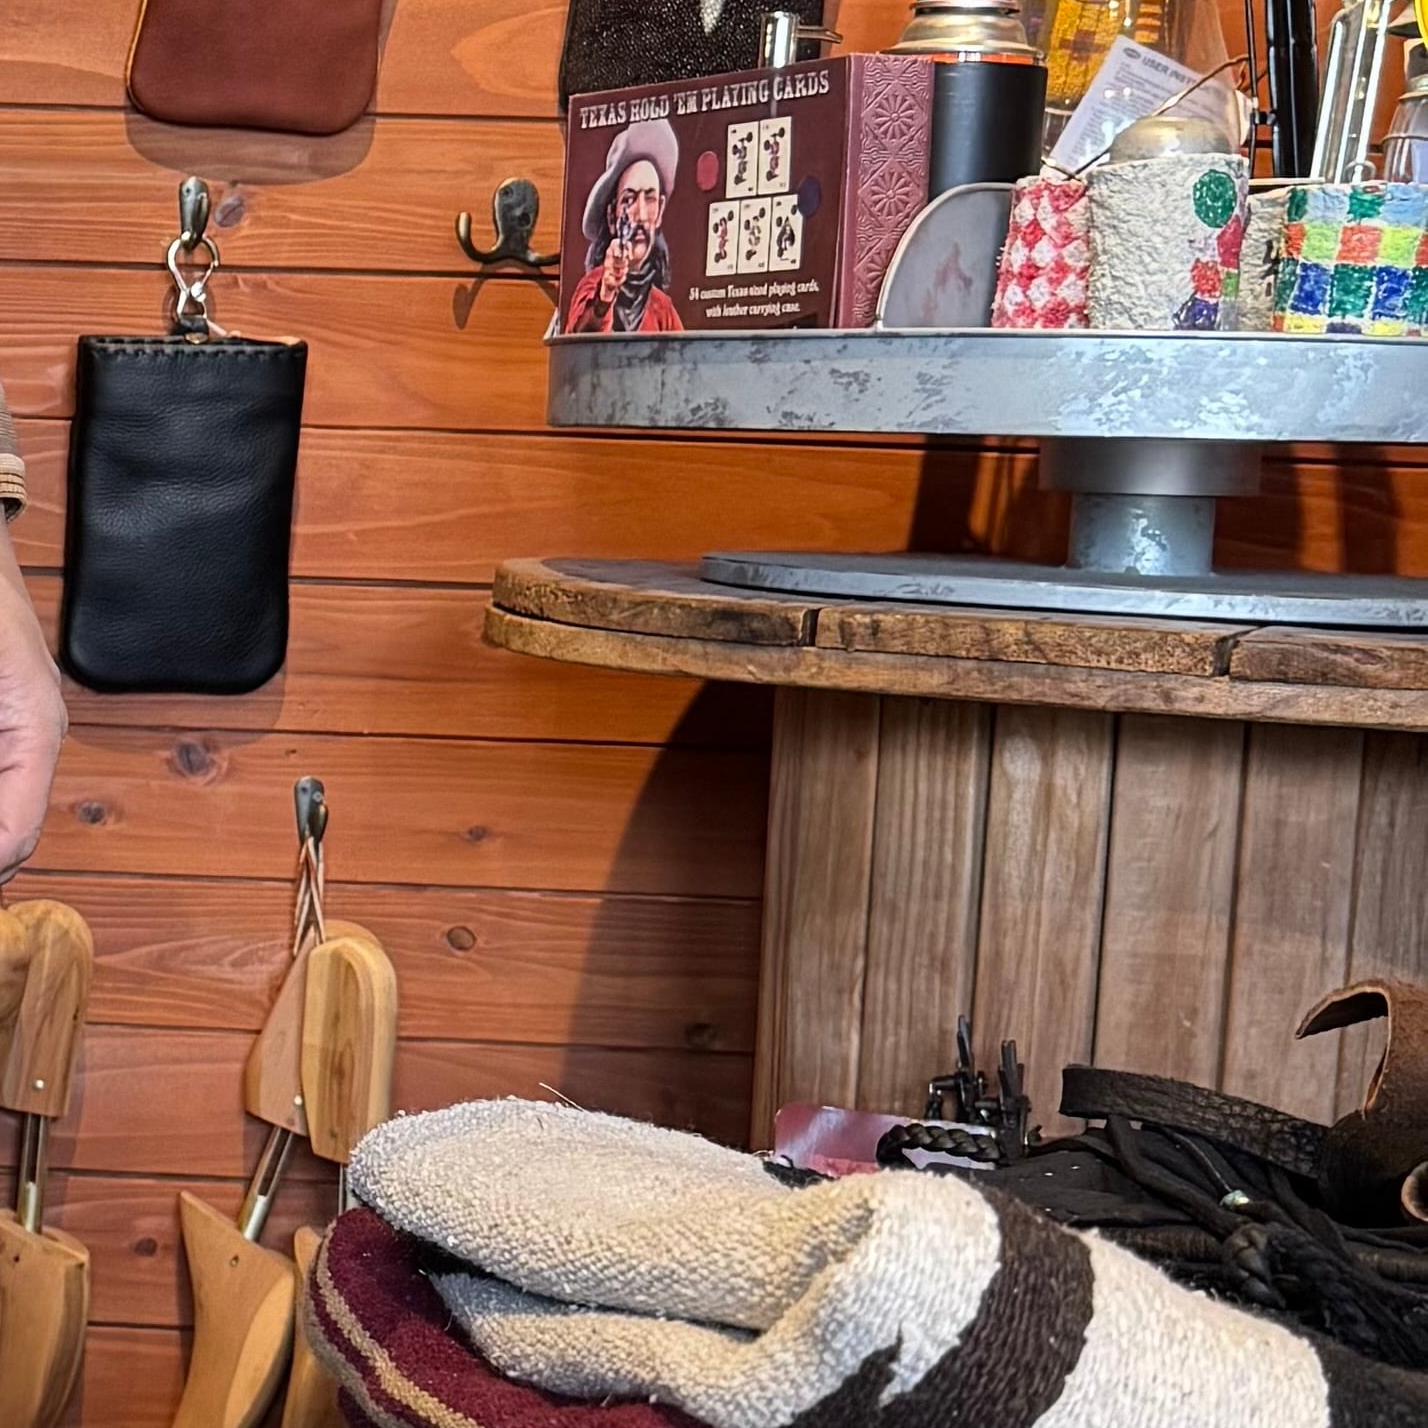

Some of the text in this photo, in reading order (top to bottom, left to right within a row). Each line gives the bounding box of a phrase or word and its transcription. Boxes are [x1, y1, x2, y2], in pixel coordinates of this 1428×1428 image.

[1141, 56, 1169, 76] USER
[580, 70, 830, 129] TEXAS HOLD 'EM PLAYING CARDS
[768, 282, 796, 298] playing
[706, 305, 722, 317] with
[723, 303, 748, 316] leather
[749, 302, 781, 316] carrying
